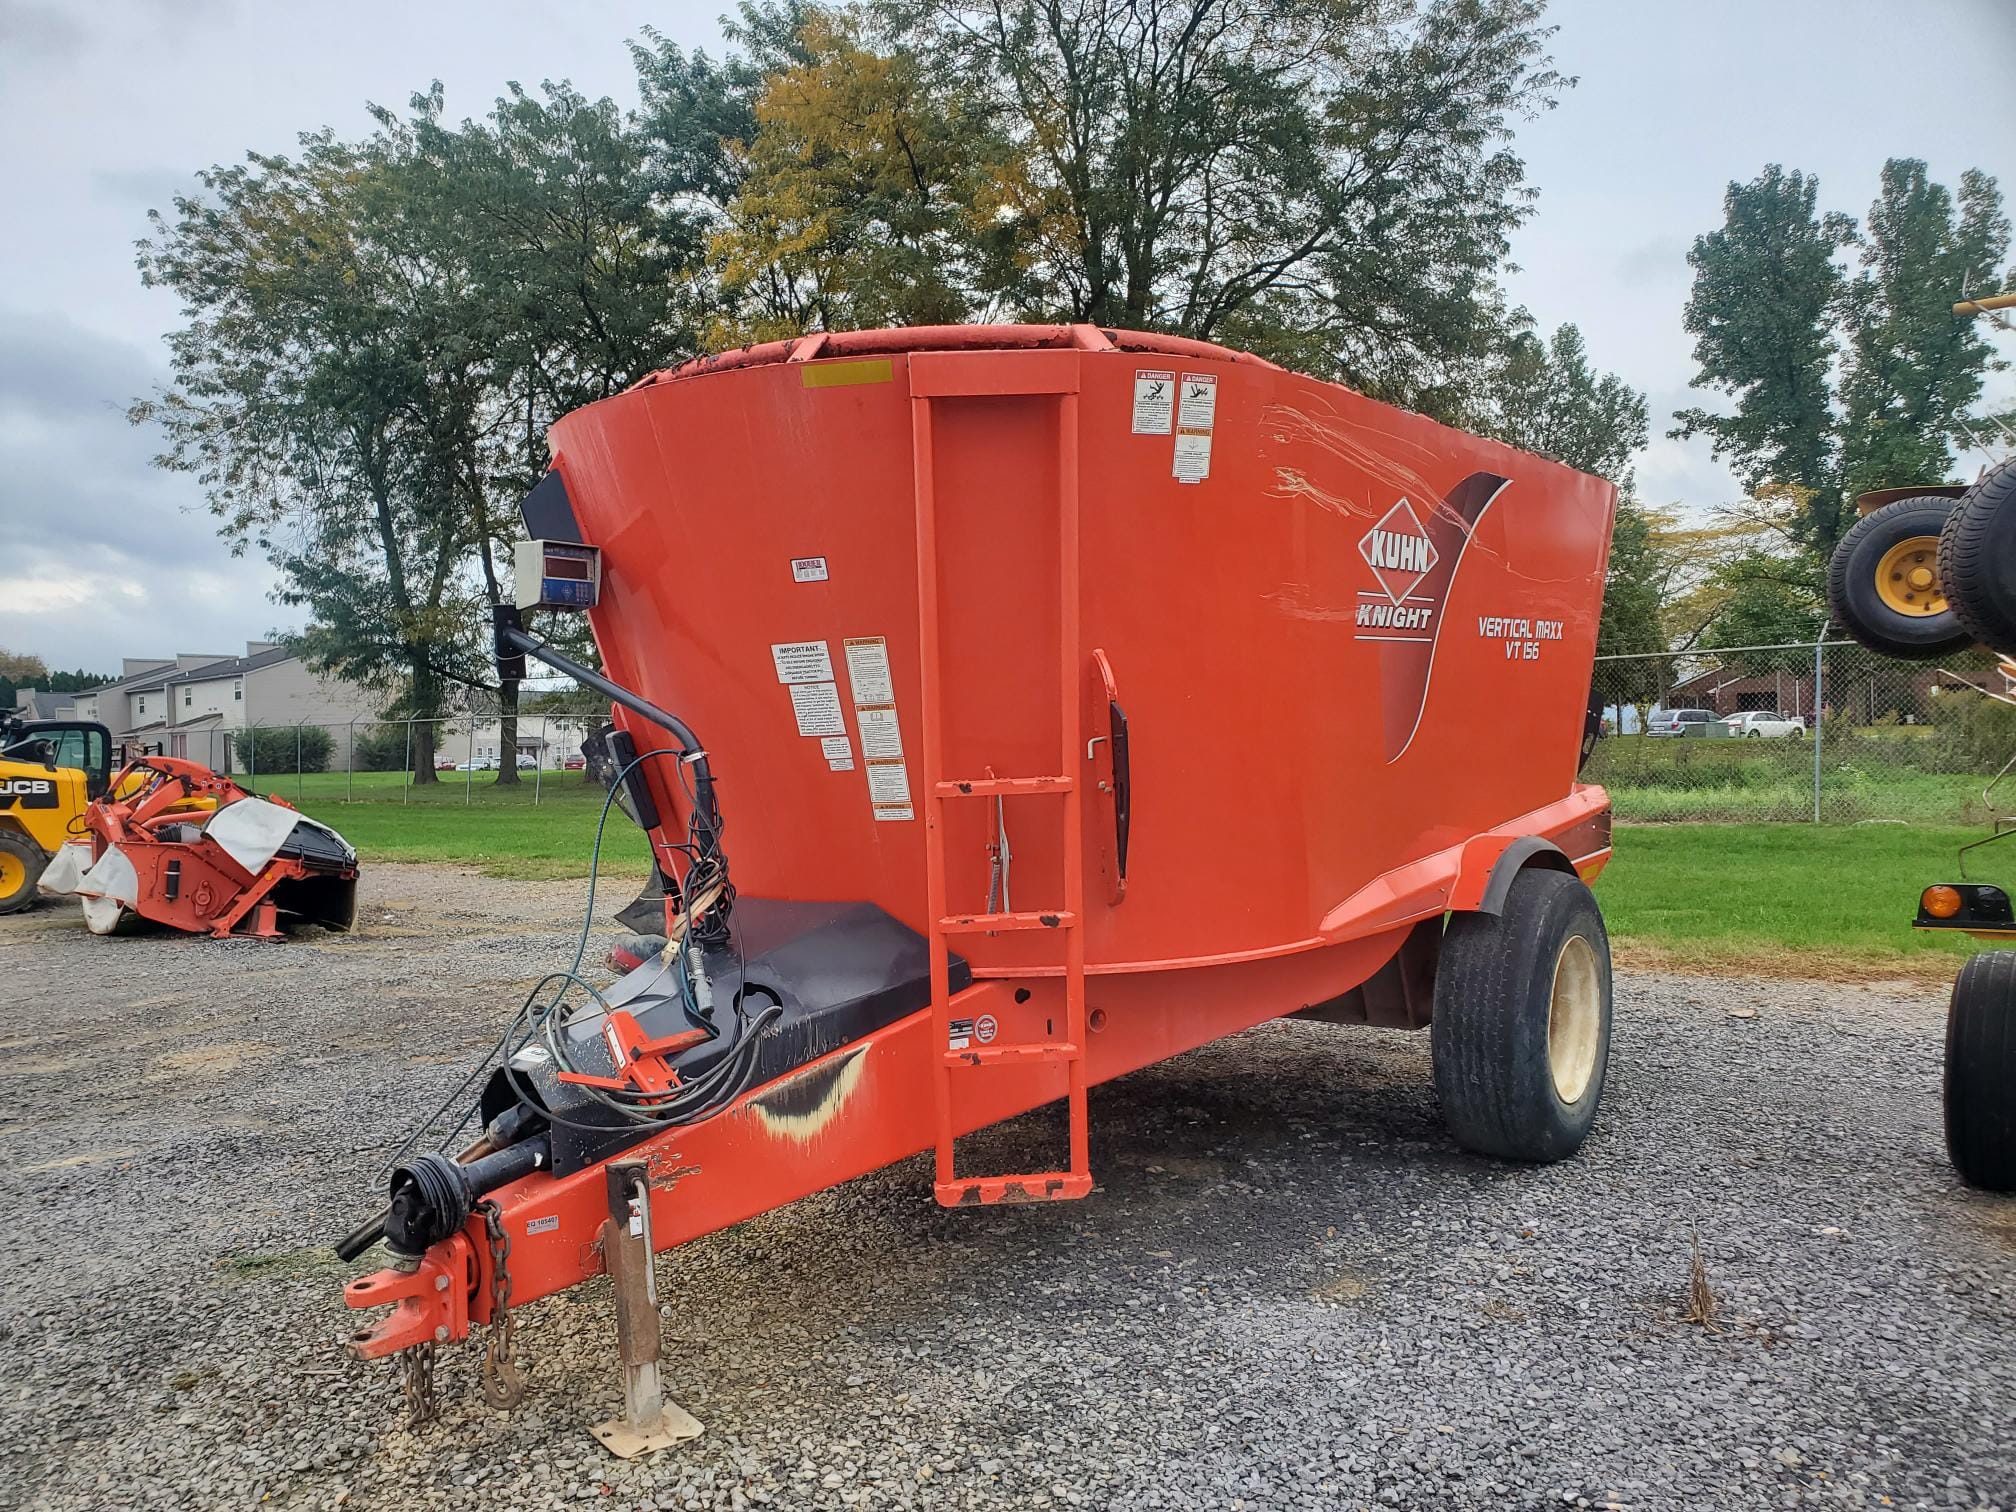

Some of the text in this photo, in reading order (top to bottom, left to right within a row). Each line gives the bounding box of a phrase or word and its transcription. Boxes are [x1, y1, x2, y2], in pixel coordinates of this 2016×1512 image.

[1147, 372, 1171, 380] DANGER
[1370, 529, 1429, 573] KUHN
[1356, 604, 1432, 630] KNIGHT
[1478, 616, 1564, 640] VERTICAL MAXX
[779, 645, 819, 654] IMPORTANT
[1506, 641, 1540, 660] VT 156
[0, 780, 50, 794] JCB
